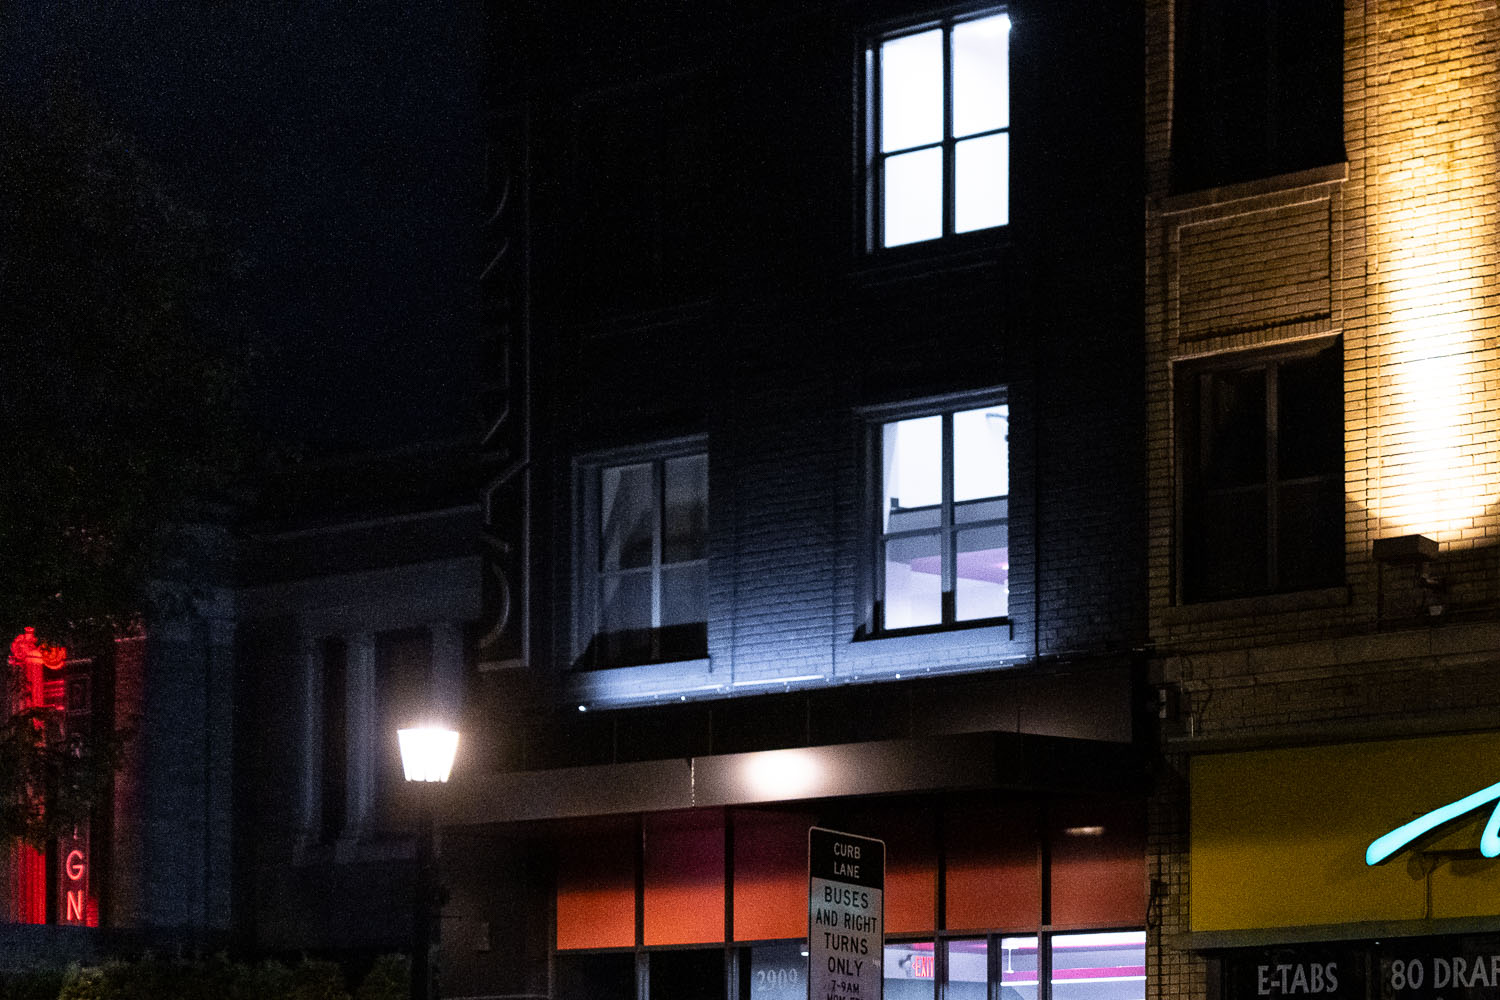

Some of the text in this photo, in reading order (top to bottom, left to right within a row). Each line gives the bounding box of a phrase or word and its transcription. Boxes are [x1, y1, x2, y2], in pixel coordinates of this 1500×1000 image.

[833, 842, 861, 860] CURB
[833, 861, 861, 879] LANE
[824, 886, 869, 909] BUSES
[816, 908, 877, 934] AND RIGHT
[824, 932, 869, 955] TURNS
[828, 956, 863, 977] ONLY
[1391, 959, 1424, 990] 80
[831, 980, 860, 994] 7-9AM
[1257, 962, 1339, 995] E-TABS
